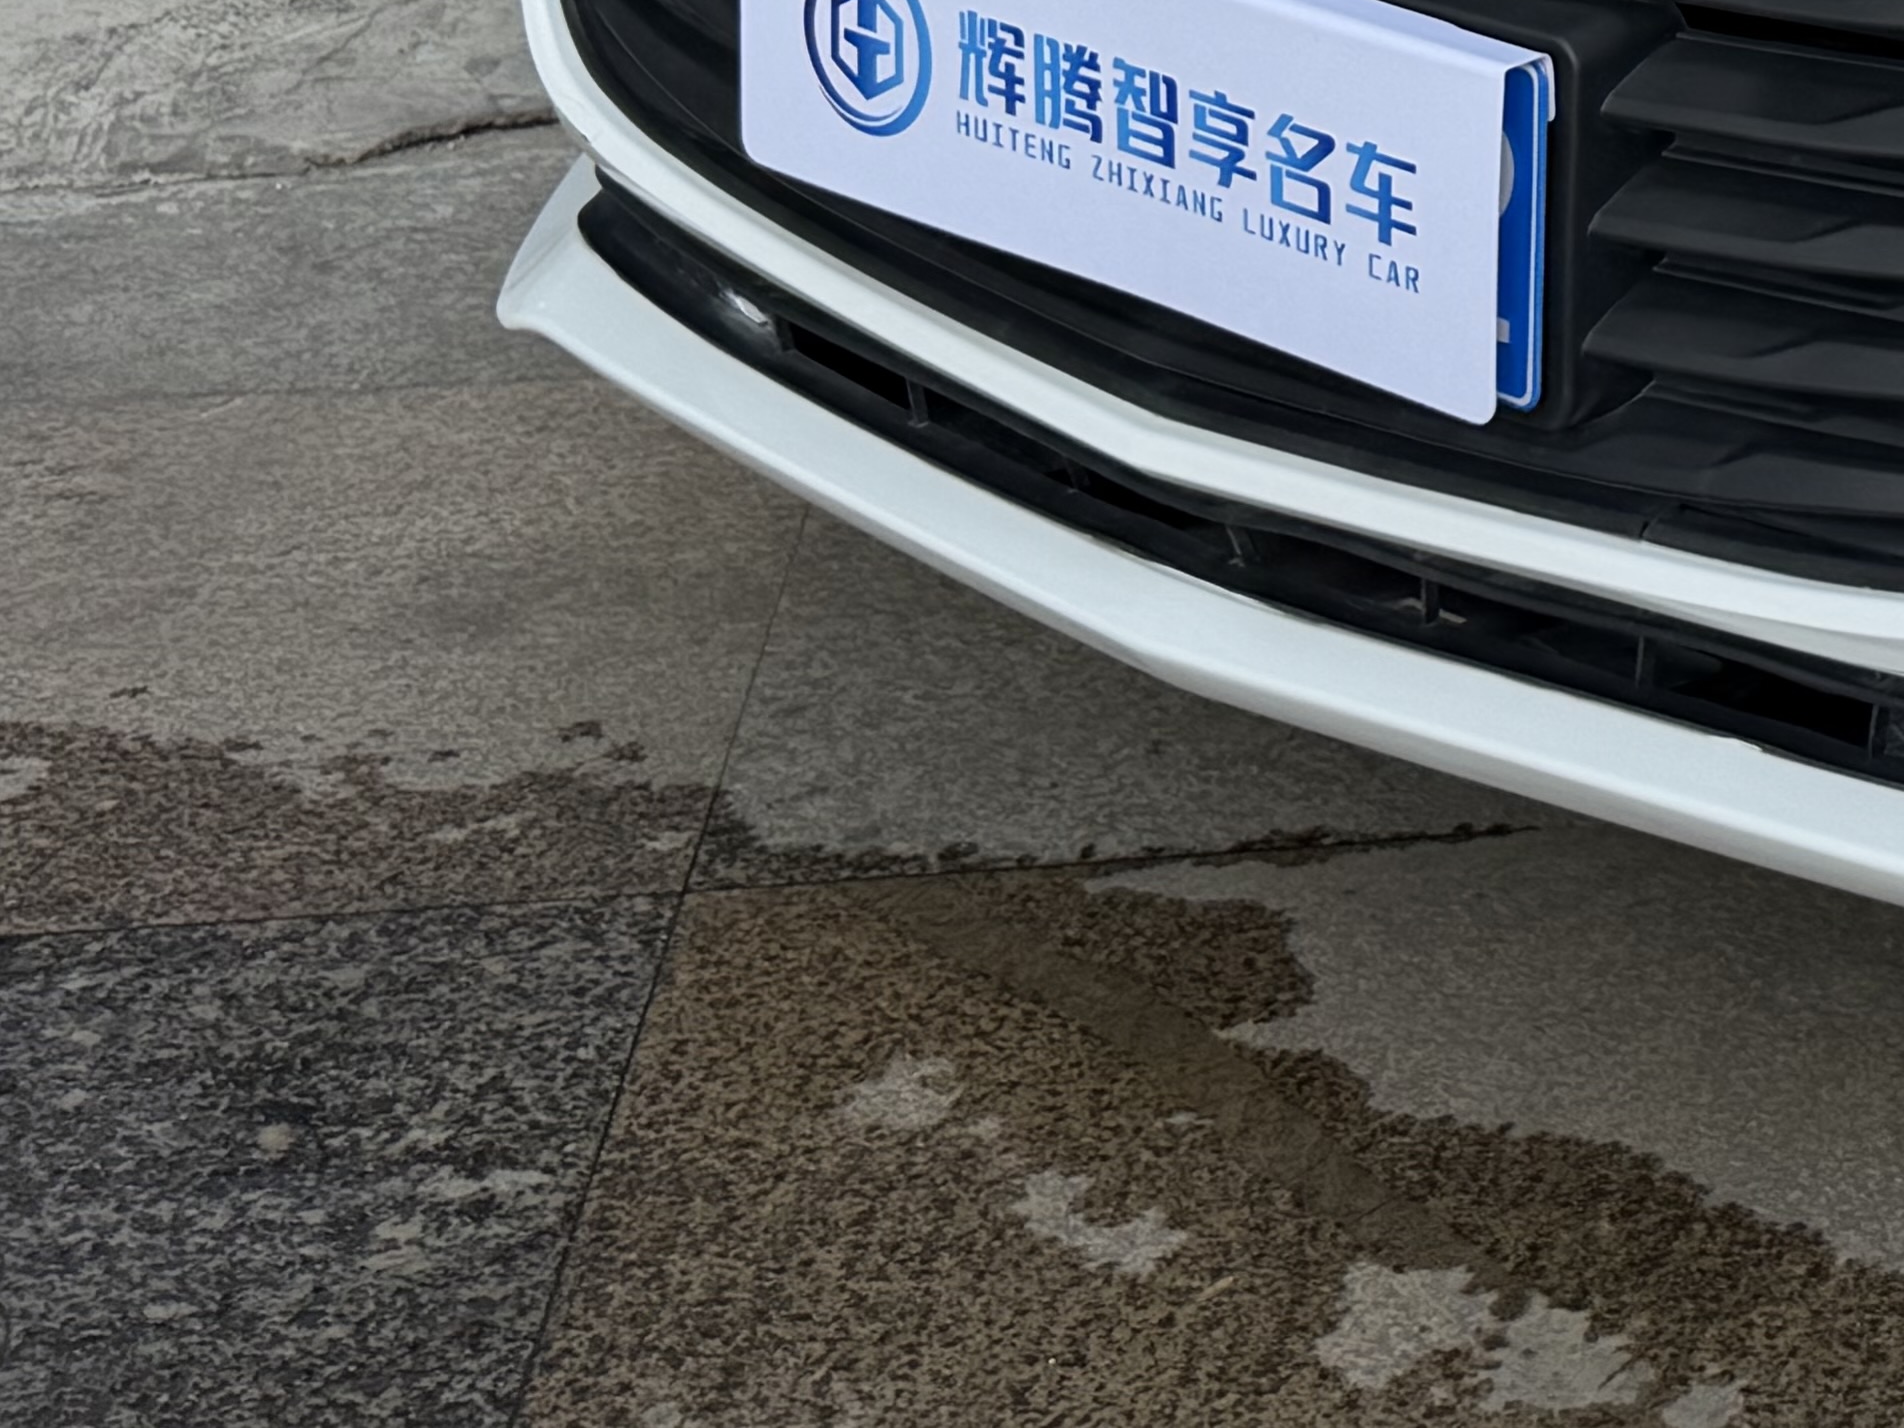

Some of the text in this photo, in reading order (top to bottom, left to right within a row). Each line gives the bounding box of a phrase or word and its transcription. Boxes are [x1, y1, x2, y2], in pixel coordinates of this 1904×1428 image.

[955, 111, 1423, 296] HUITENG ZHIXIANG LUXURY CAR
[957, 8, 1420, 248] 辉腾智享名车
